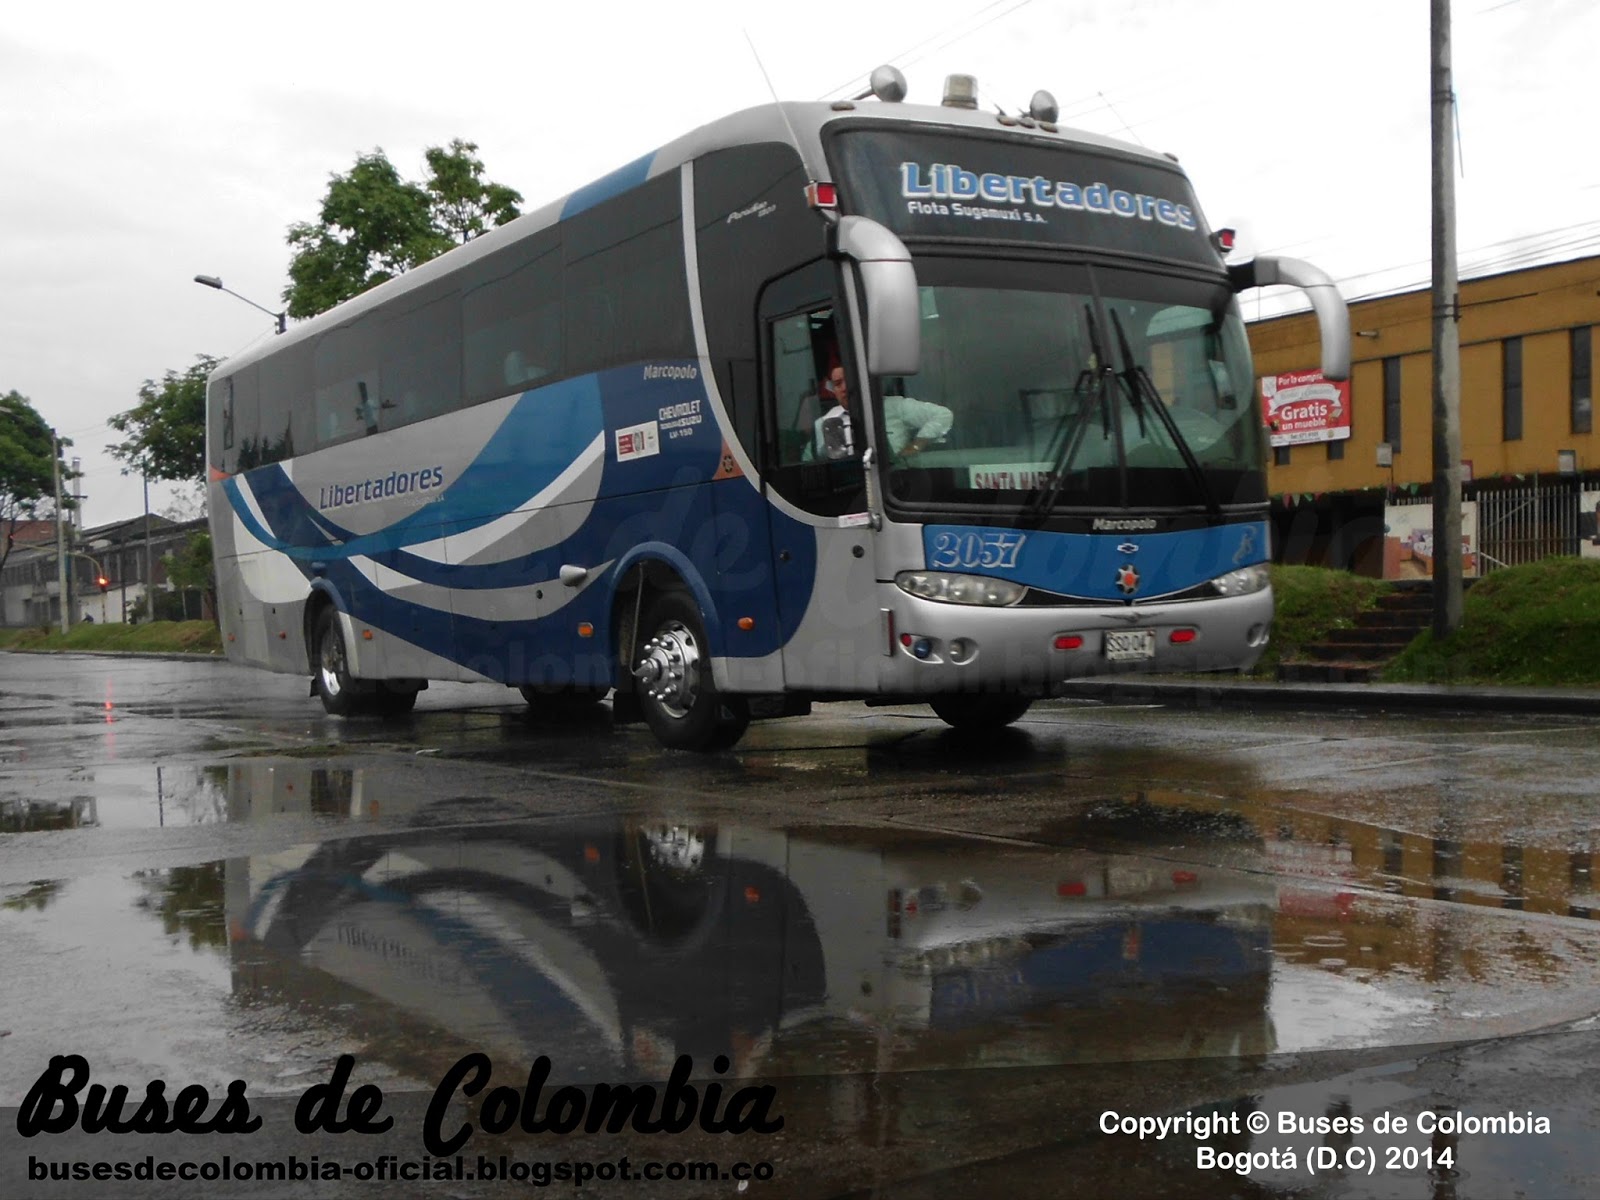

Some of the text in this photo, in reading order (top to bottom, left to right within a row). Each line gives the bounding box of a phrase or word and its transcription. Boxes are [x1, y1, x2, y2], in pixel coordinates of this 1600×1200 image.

[902, 162, 1198, 231] Libertadores
[907, 201, 949, 216] Flota
[952, 203, 1021, 221] Sugamuxi
[643, 364, 697, 380] Marcopolo
[658, 400, 701, 421] CHEVROLET
[1281, 402, 1328, 421] Gratis
[1282, 422, 1293, 431] un
[320, 466, 443, 510] Libertadores
[1093, 518, 1157, 530] Marcopolo
[931, 531, 1027, 569] 2057
